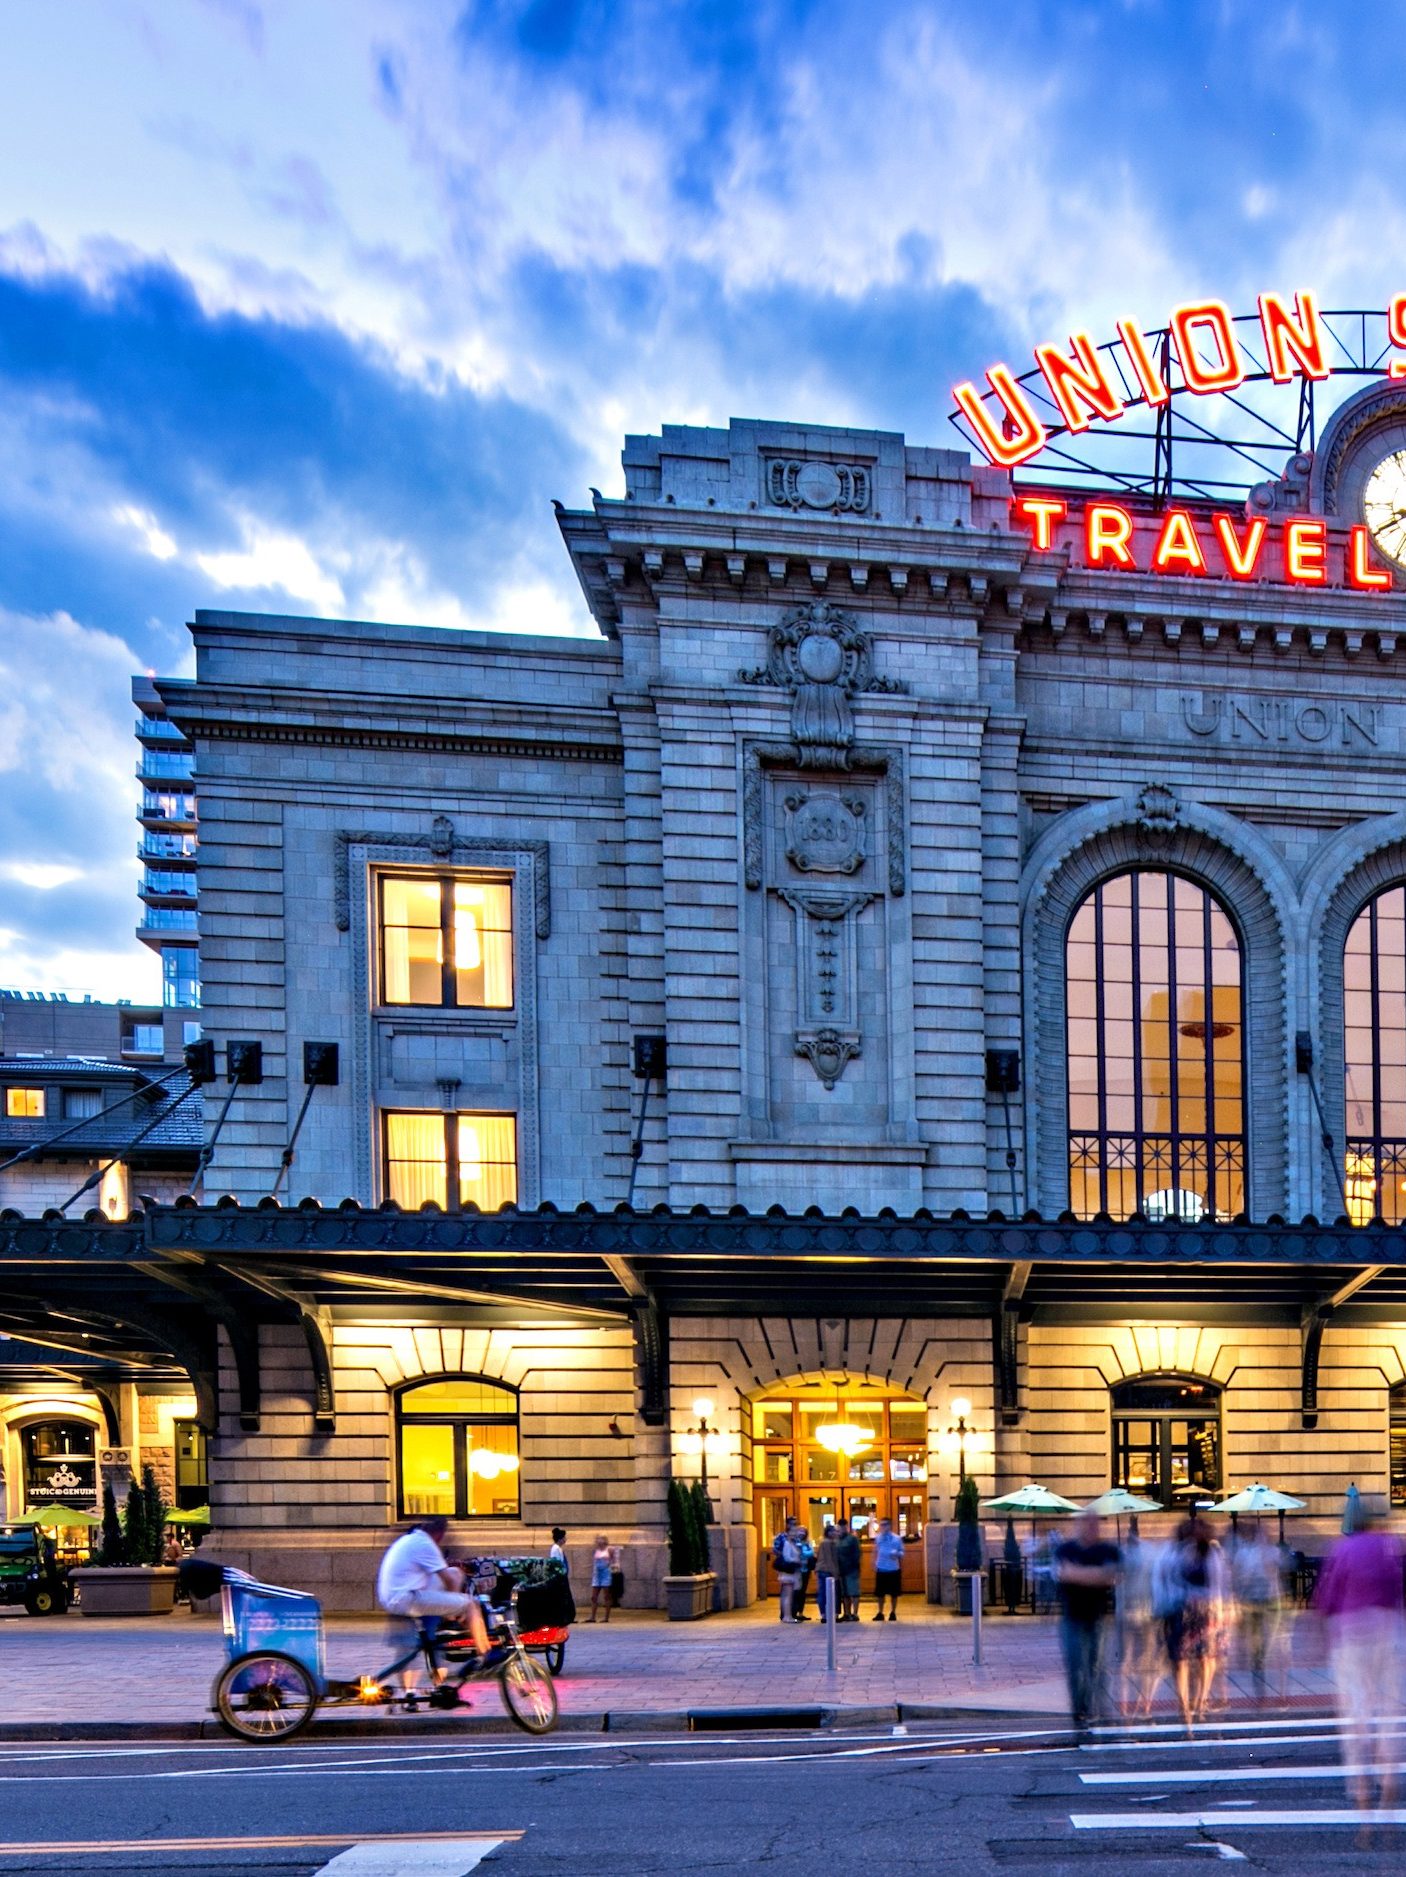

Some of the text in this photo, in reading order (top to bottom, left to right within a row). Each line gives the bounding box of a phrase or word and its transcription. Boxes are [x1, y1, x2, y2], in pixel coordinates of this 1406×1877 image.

[952, 288, 1331, 468] UNION
[1016, 497, 1392, 590] TRAVEL
[1181, 697, 1381, 746] UNION
